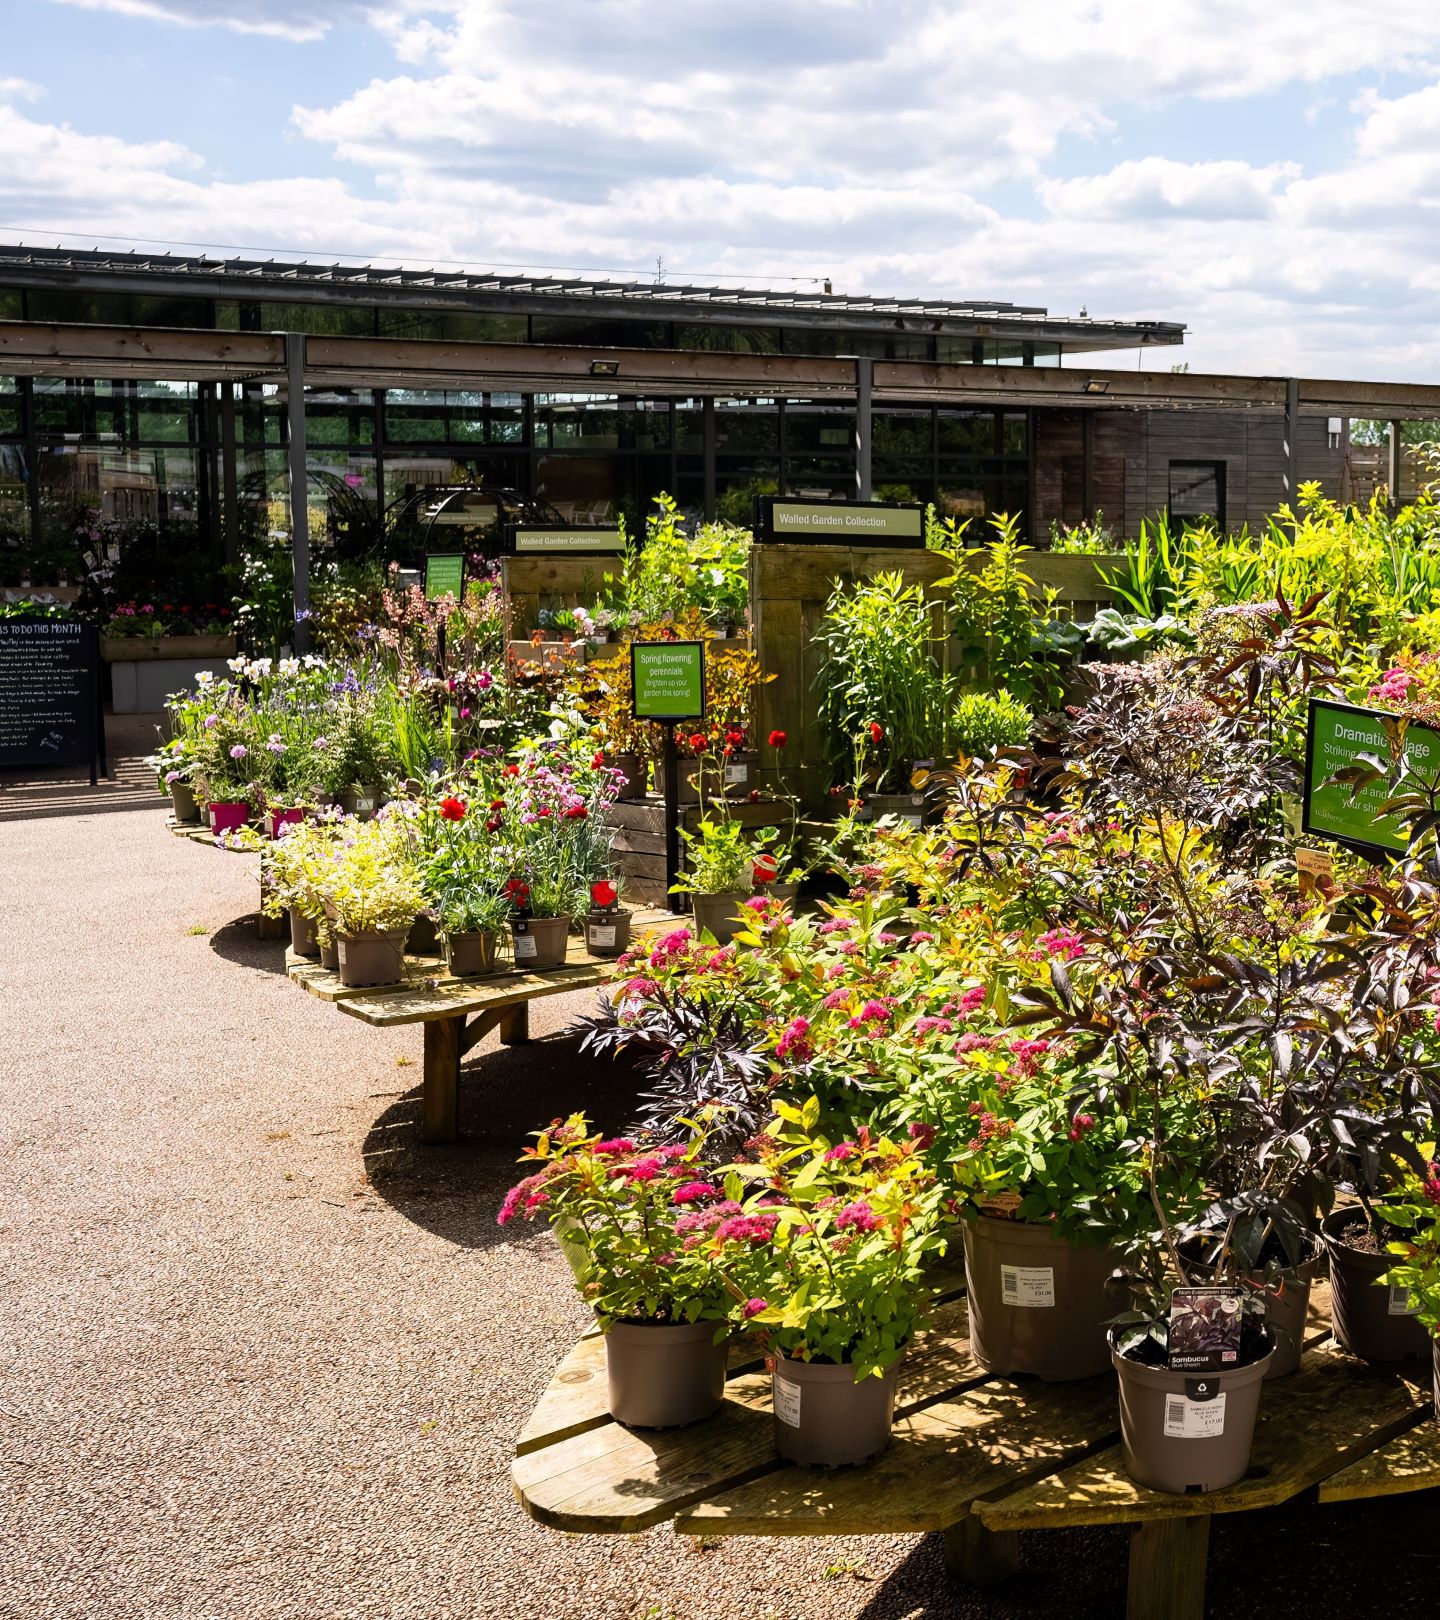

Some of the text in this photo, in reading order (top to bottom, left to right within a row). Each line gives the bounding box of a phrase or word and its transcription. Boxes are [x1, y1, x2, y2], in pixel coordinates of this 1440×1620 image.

[779, 513, 886, 527] Walled Garden Collection
[520, 537, 601, 545] Walled Garden Collection
[33, 624, 49, 634] THIS
[51, 623, 81, 634] MONTH
[640, 653, 692, 665] Spring flowering
[649, 667, 683, 676] perennials
[645, 679, 668, 688] Brighten
[643, 689, 662, 699] garden
[1334, 723, 1388, 748] Dramatic
[1323, 742, 1356, 761] Striking
[1369, 786, 1387, 800] and
